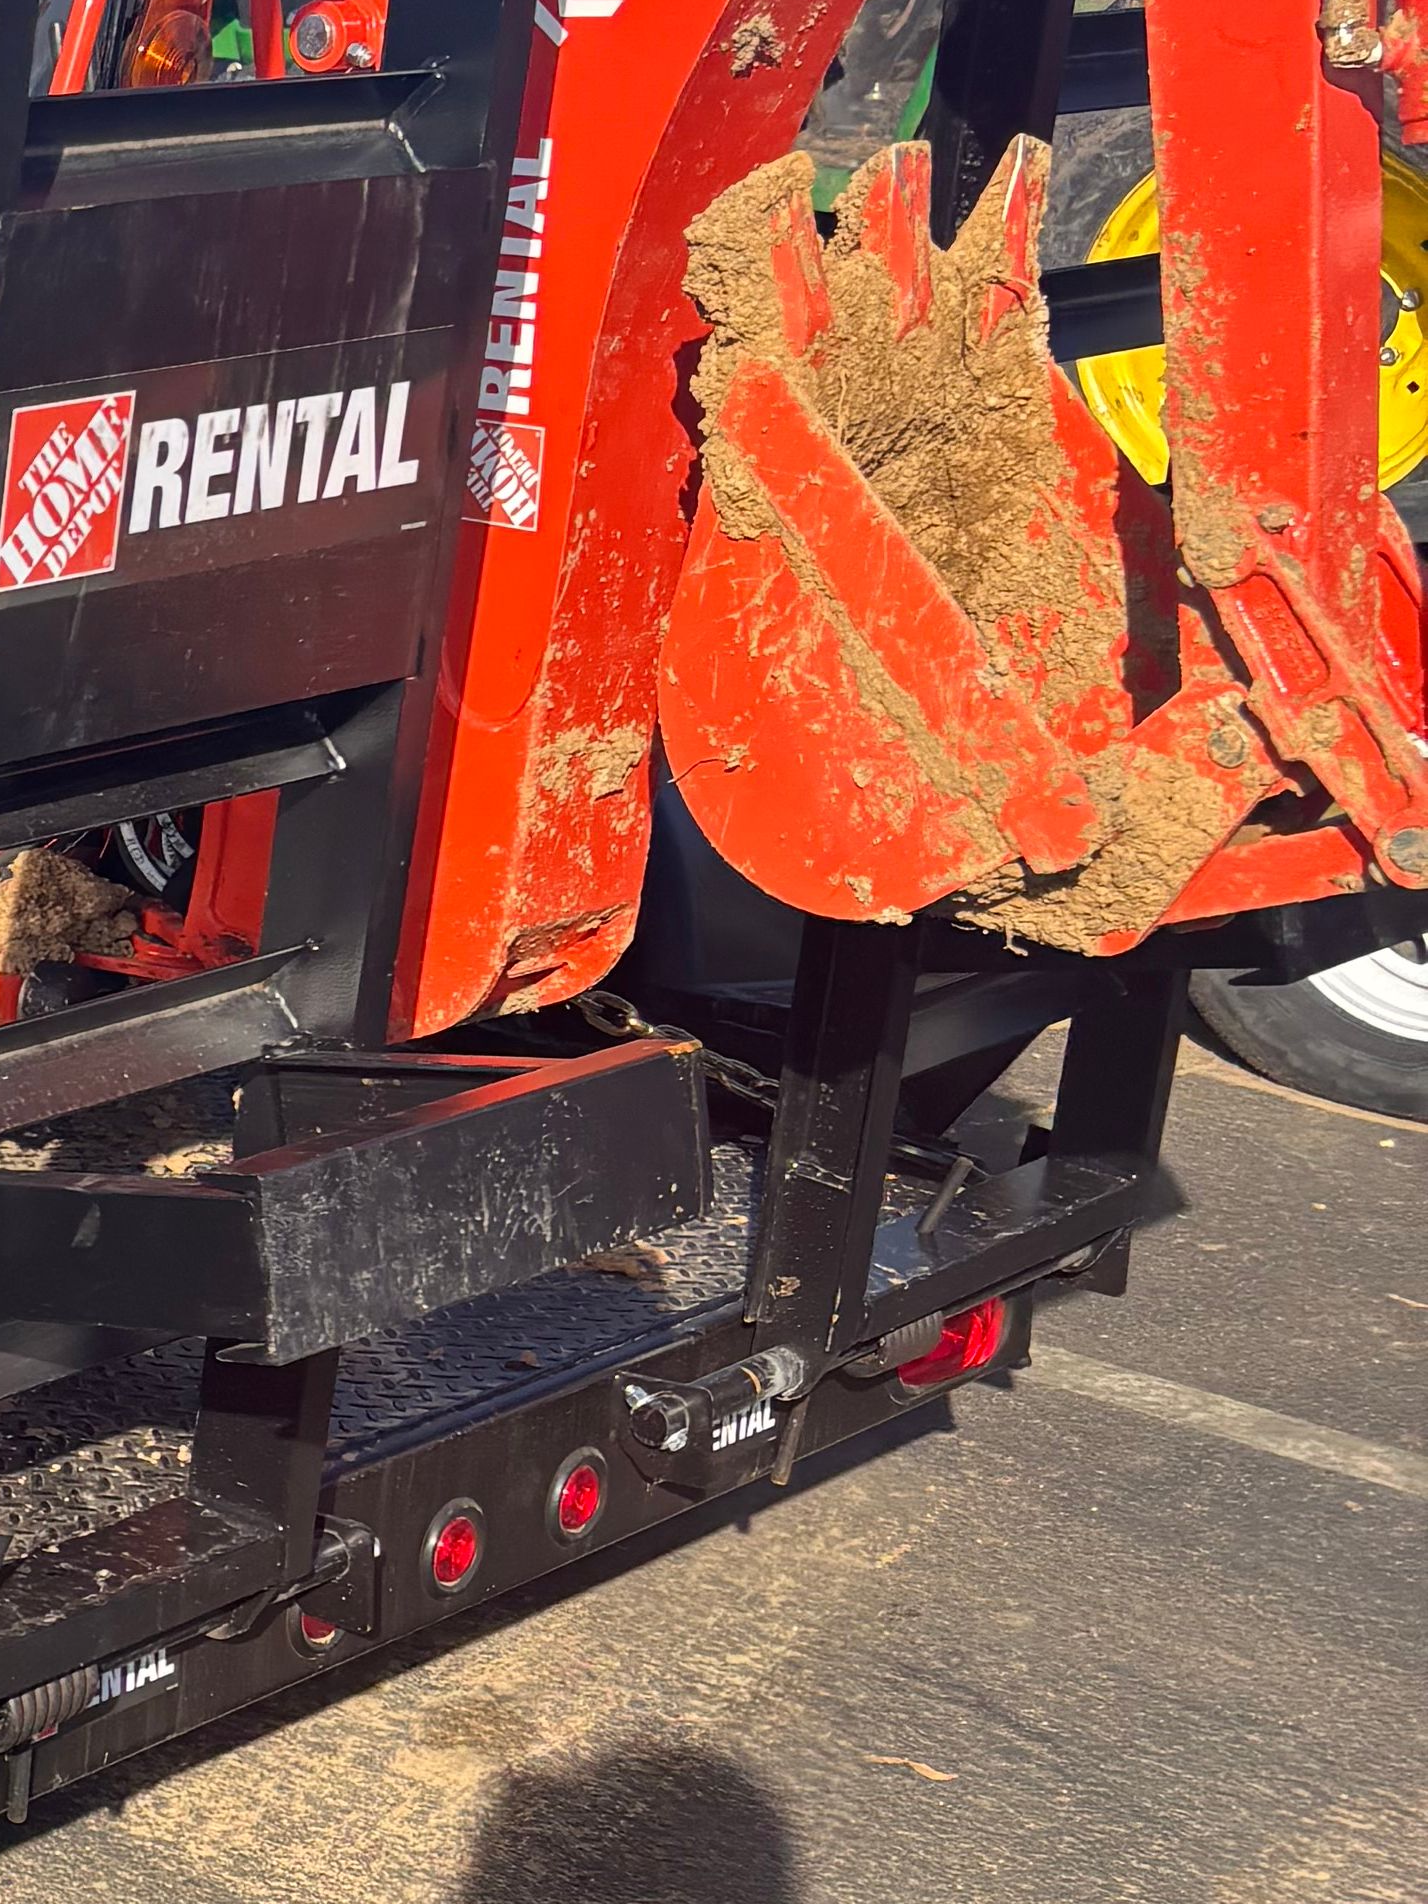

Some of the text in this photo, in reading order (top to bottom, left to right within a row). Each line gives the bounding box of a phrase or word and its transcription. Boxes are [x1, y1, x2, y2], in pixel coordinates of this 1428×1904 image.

[477, 137, 553, 416] RENTAL
[0, 397, 131, 585] HOME
[17, 421, 74, 498] THE
[43, 462, 122, 577] DEPOT
[128, 381, 419, 535] RENTAL
